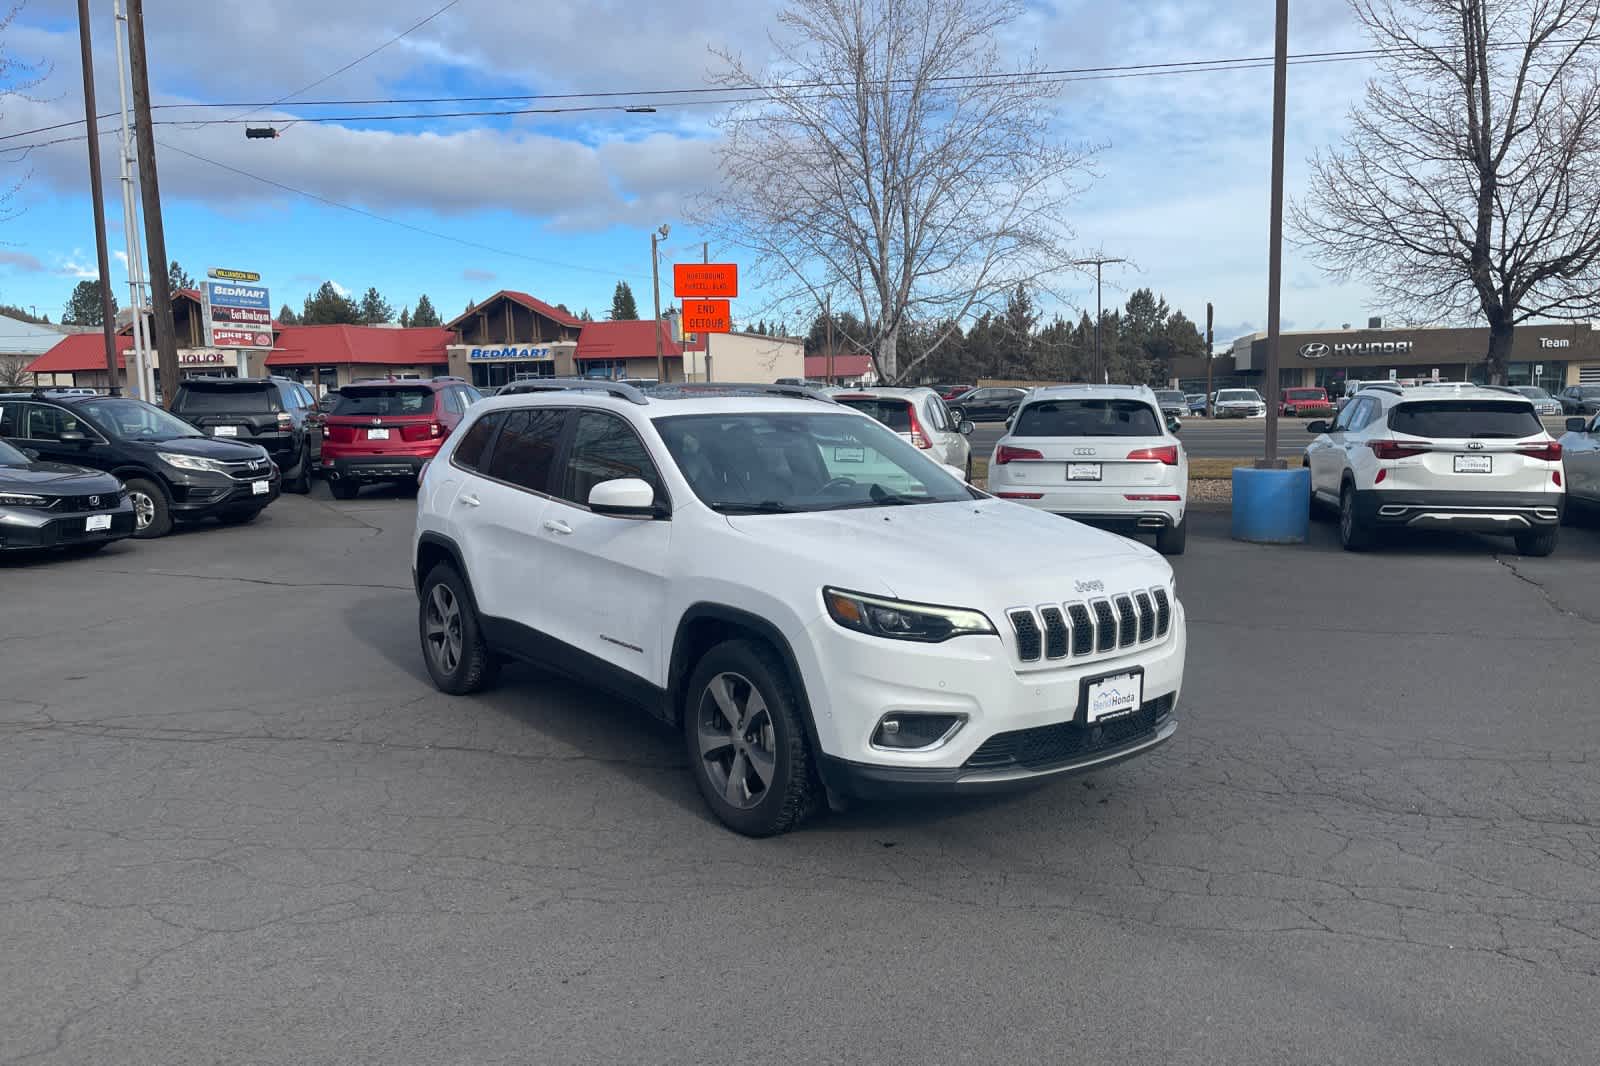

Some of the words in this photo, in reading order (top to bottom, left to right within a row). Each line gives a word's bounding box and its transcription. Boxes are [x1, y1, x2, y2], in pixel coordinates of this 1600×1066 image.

[697, 304, 715, 314] END
[689, 317, 724, 328] DETOUR
[1333, 341, 1413, 354] HYUNDAI
[1539, 337, 1569, 348] Team
[470, 346, 551, 359] BEDMART
[1074, 578, 1104, 592] Jeep
